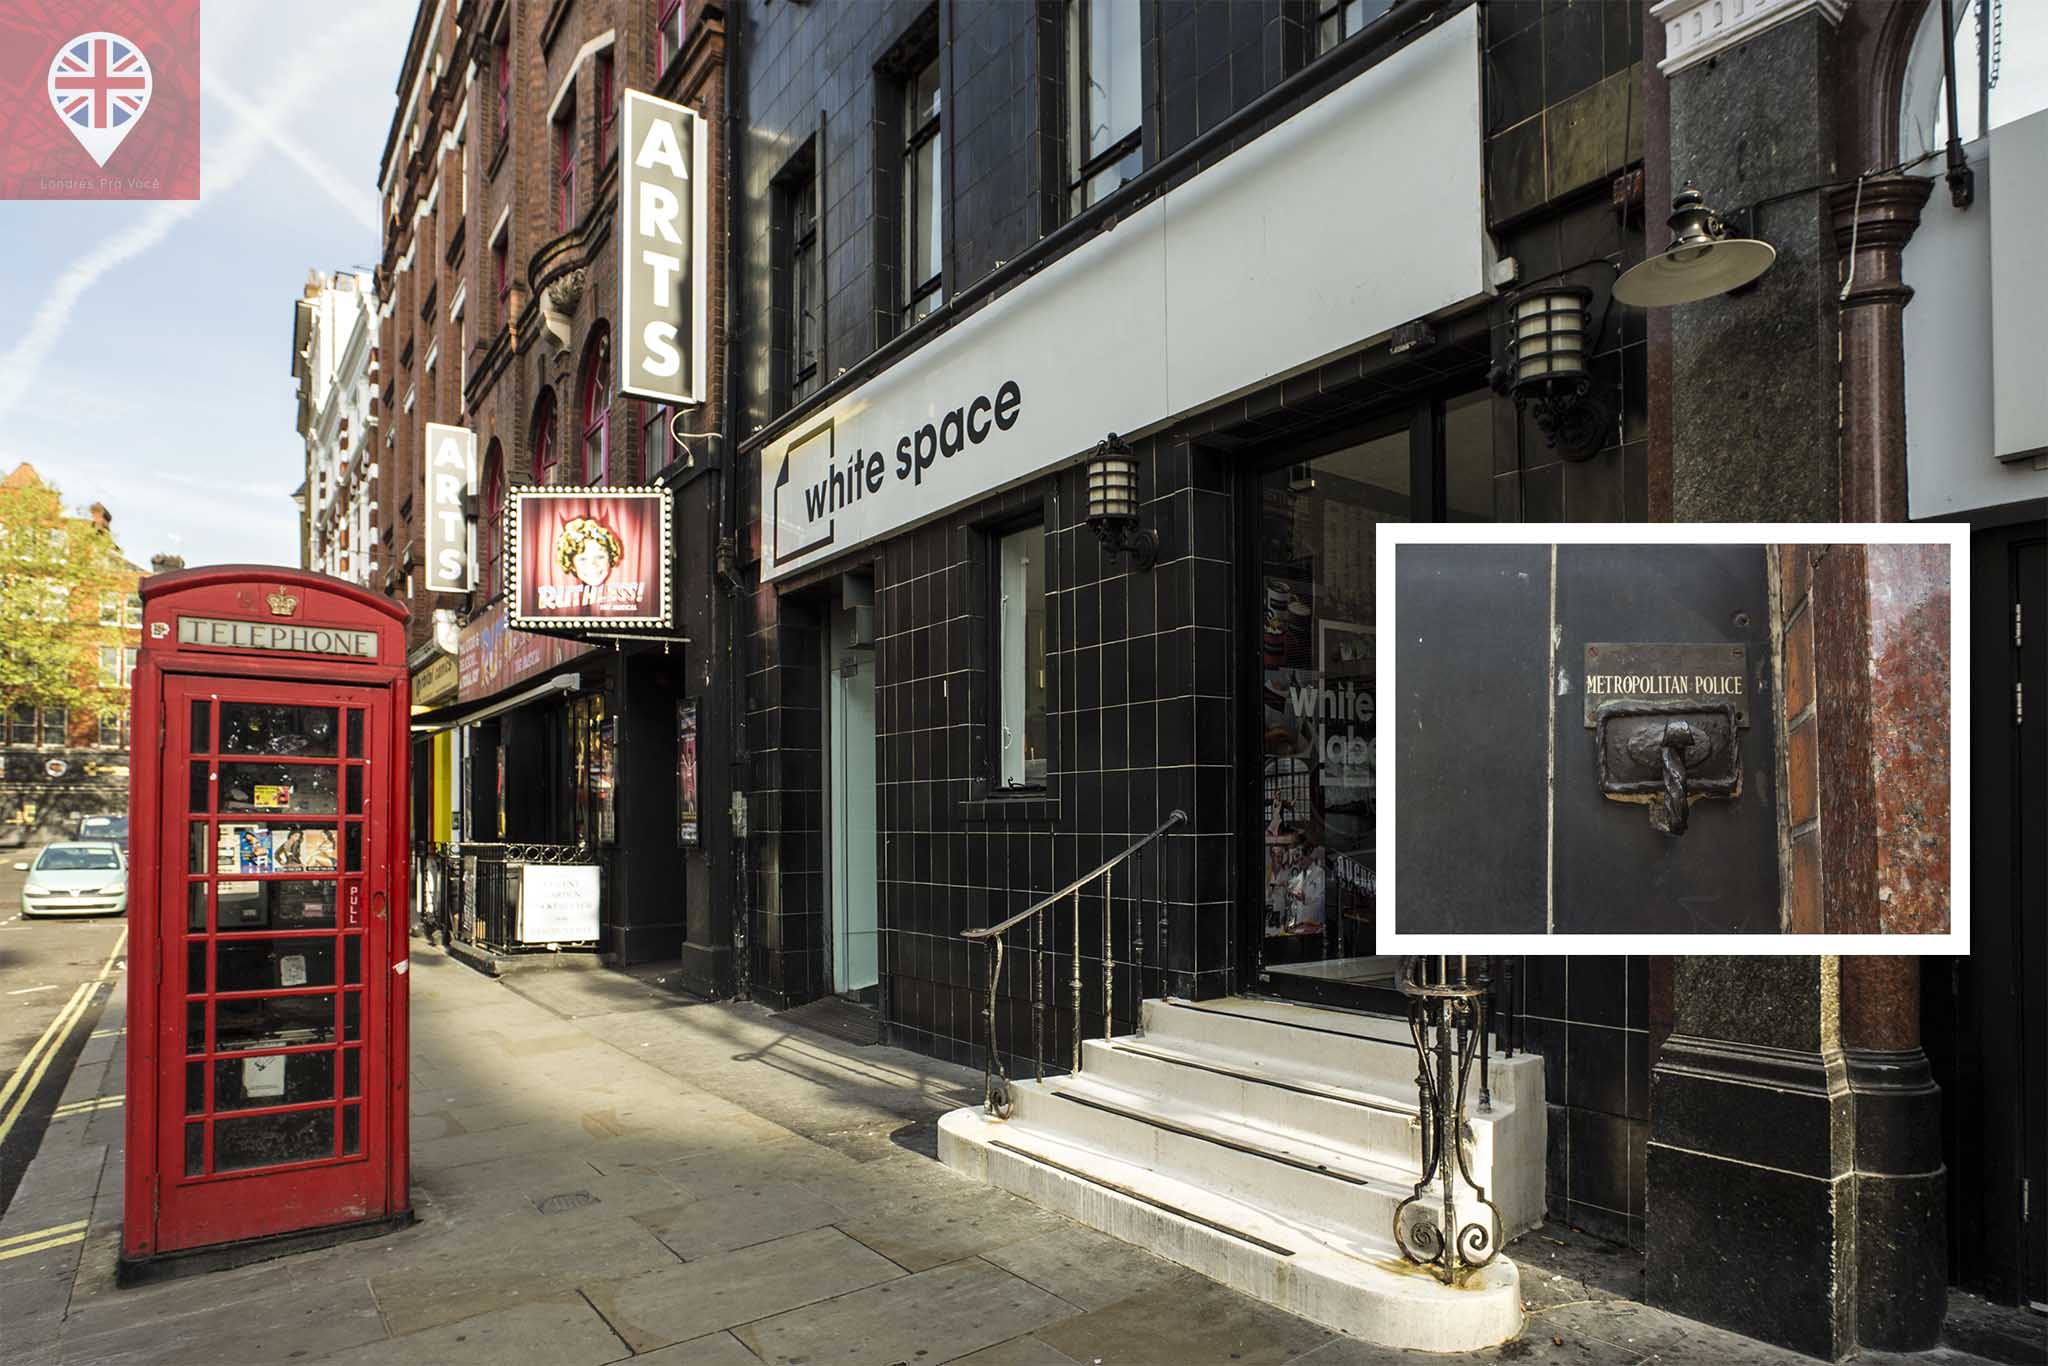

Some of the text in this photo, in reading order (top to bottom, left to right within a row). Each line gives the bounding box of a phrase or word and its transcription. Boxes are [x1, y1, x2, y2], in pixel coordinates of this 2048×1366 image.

[635, 118, 688, 377] ARTS
[805, 380, 1022, 523] white space
[433, 437, 465, 580] ARTS
[187, 619, 369, 656] TELEPHONE
[1289, 678, 1375, 721] white
[1586, 675, 1743, 695] METROPOLITAN POLICE
[350, 886, 359, 924] PULL
